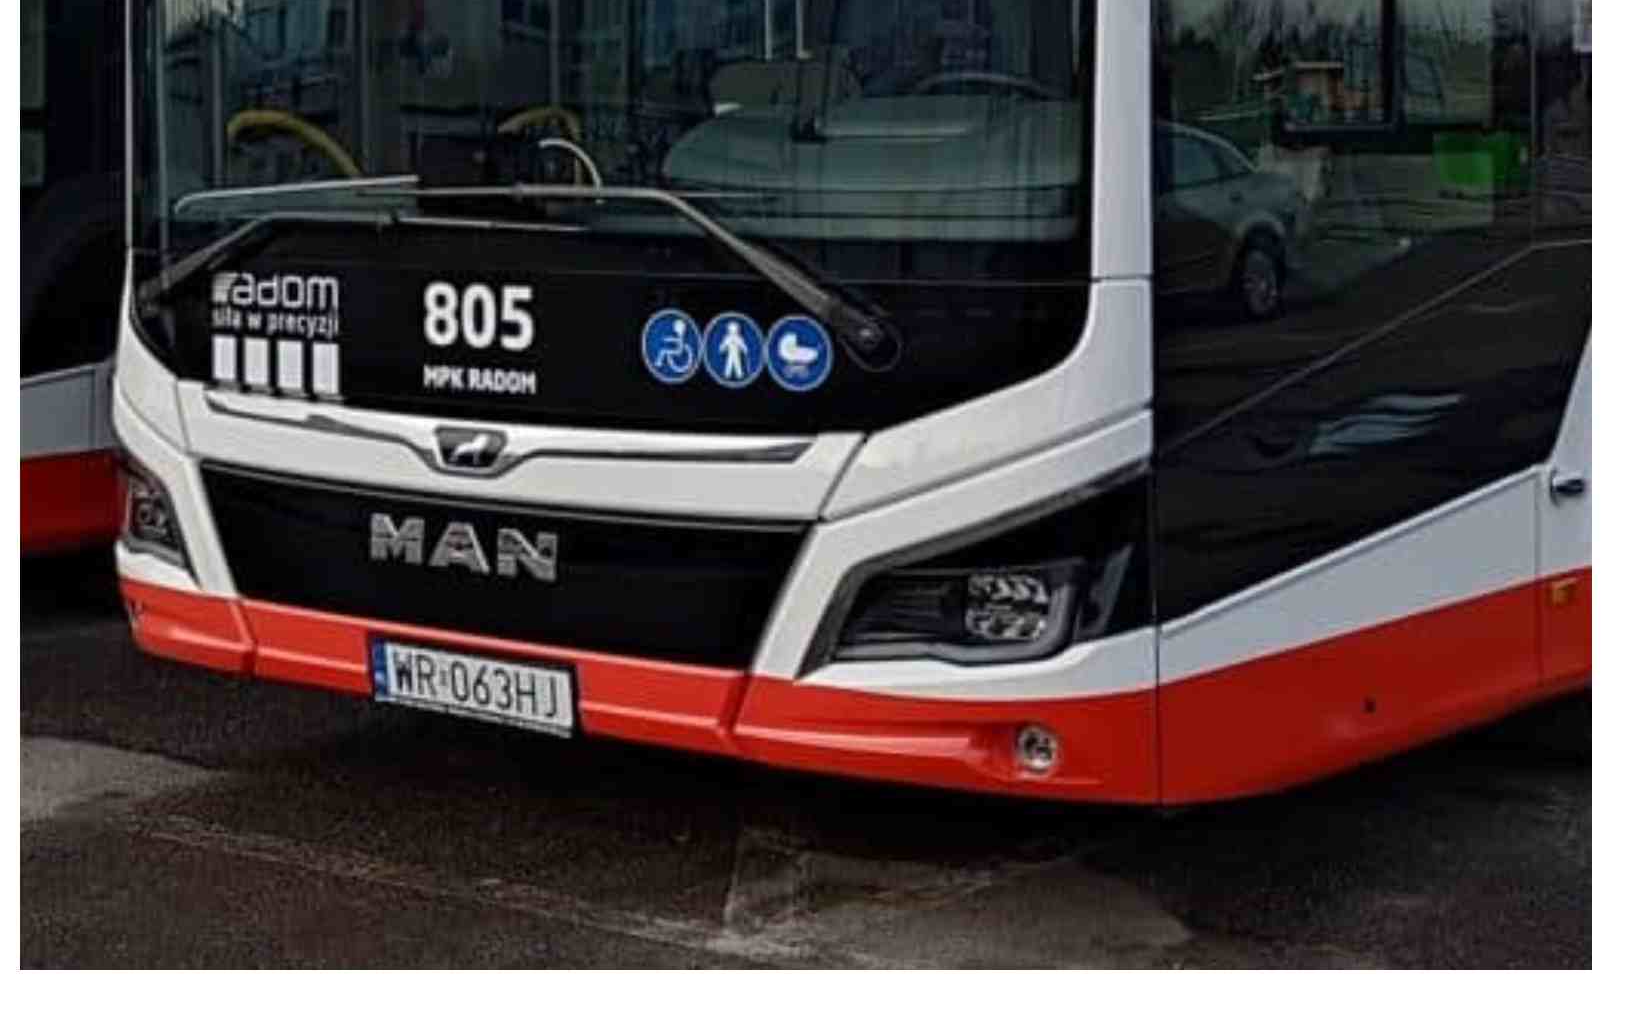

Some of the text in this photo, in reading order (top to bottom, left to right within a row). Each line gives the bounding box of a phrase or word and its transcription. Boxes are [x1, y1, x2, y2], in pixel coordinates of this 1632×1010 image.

[213, 271, 534, 351] radom 805
[423, 364, 536, 394] MPK RADOM
[371, 512, 558, 582] MAN
